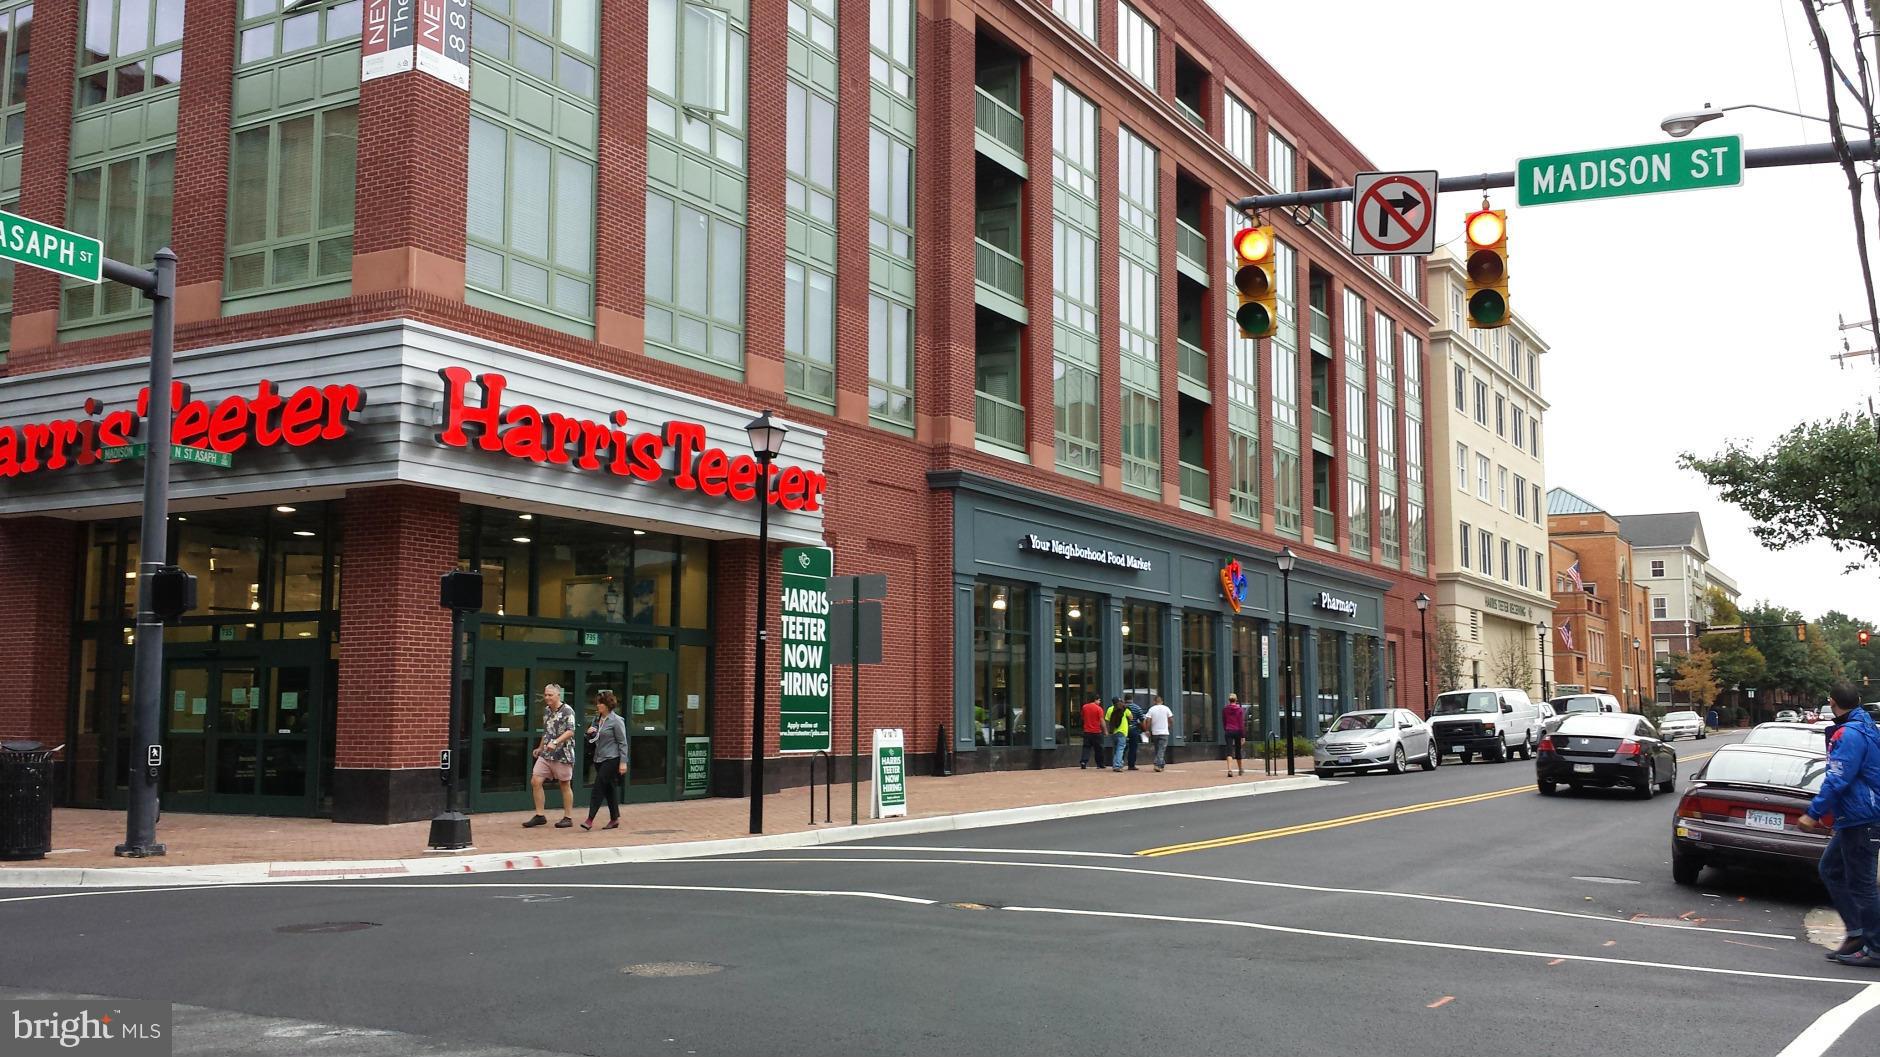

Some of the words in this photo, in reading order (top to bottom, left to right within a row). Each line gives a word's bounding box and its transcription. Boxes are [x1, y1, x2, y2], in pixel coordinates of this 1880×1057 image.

[1533, 154, 1671, 195] MADISON
[1692, 147, 1728, 177] ST
[80, 251, 94, 263] ST
[440, 366, 663, 482] Harris
[662, 420, 826, 512] Teeter
[174, 447, 181, 458] N
[184, 448, 193, 460] ST
[195, 450, 217, 463] ASAPH
[1029, 534, 1051, 551] Your
[1051, 540, 1106, 563] Neighborhood
[1107, 551, 1126, 567] Food
[1126, 555, 1151, 571] Market
[781, 587, 830, 615] HARRIS
[1321, 592, 1357, 618] Pharmacy
[781, 615, 827, 642] TEETER
[784, 643, 824, 669] NOW
[780, 671, 829, 697] HIRING
[881, 756, 902, 766] HARRIS
[882, 765, 901, 775] TEETER
[882, 783, 903, 793] HIRING
[884, 774, 900, 783] NOW
